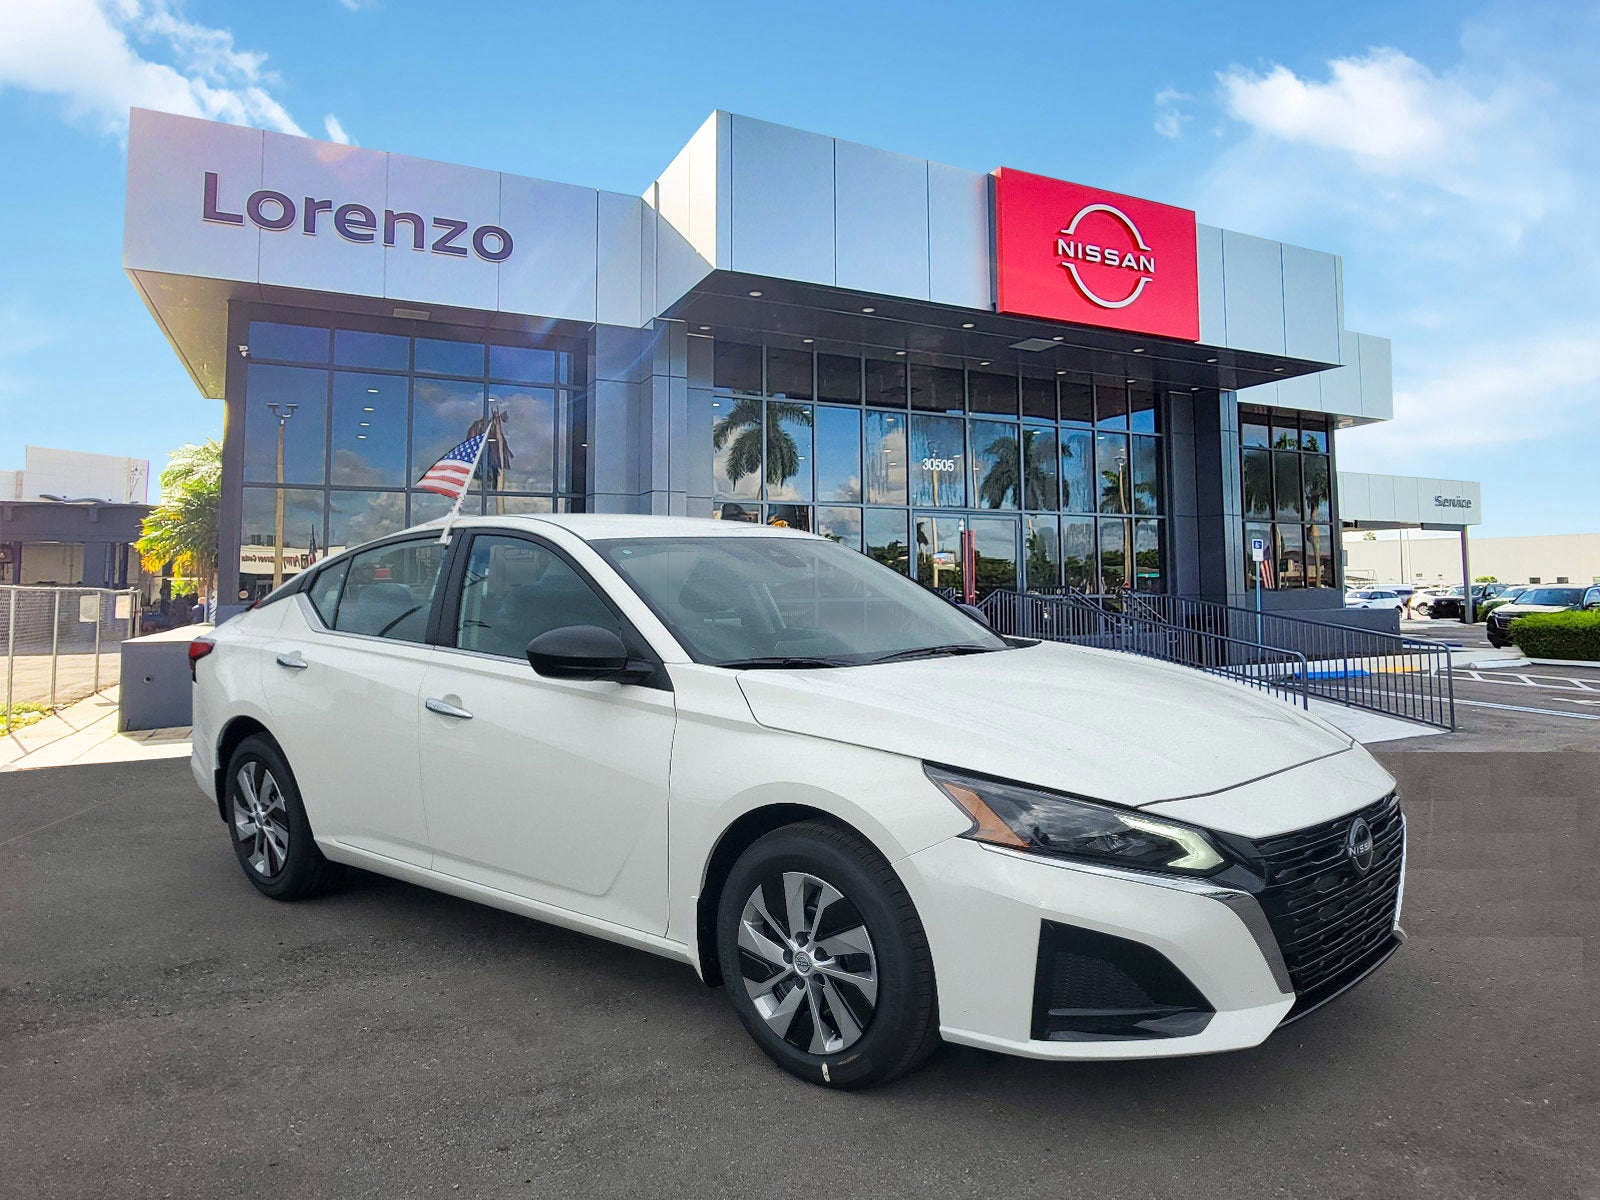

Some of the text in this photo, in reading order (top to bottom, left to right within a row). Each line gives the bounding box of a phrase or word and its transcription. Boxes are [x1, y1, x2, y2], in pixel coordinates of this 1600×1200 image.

[202, 171, 514, 262] Lorenzo
[1057, 238, 1155, 273] NISSAN
[922, 458, 955, 472] 30505
[1434, 495, 1472, 509] Service
